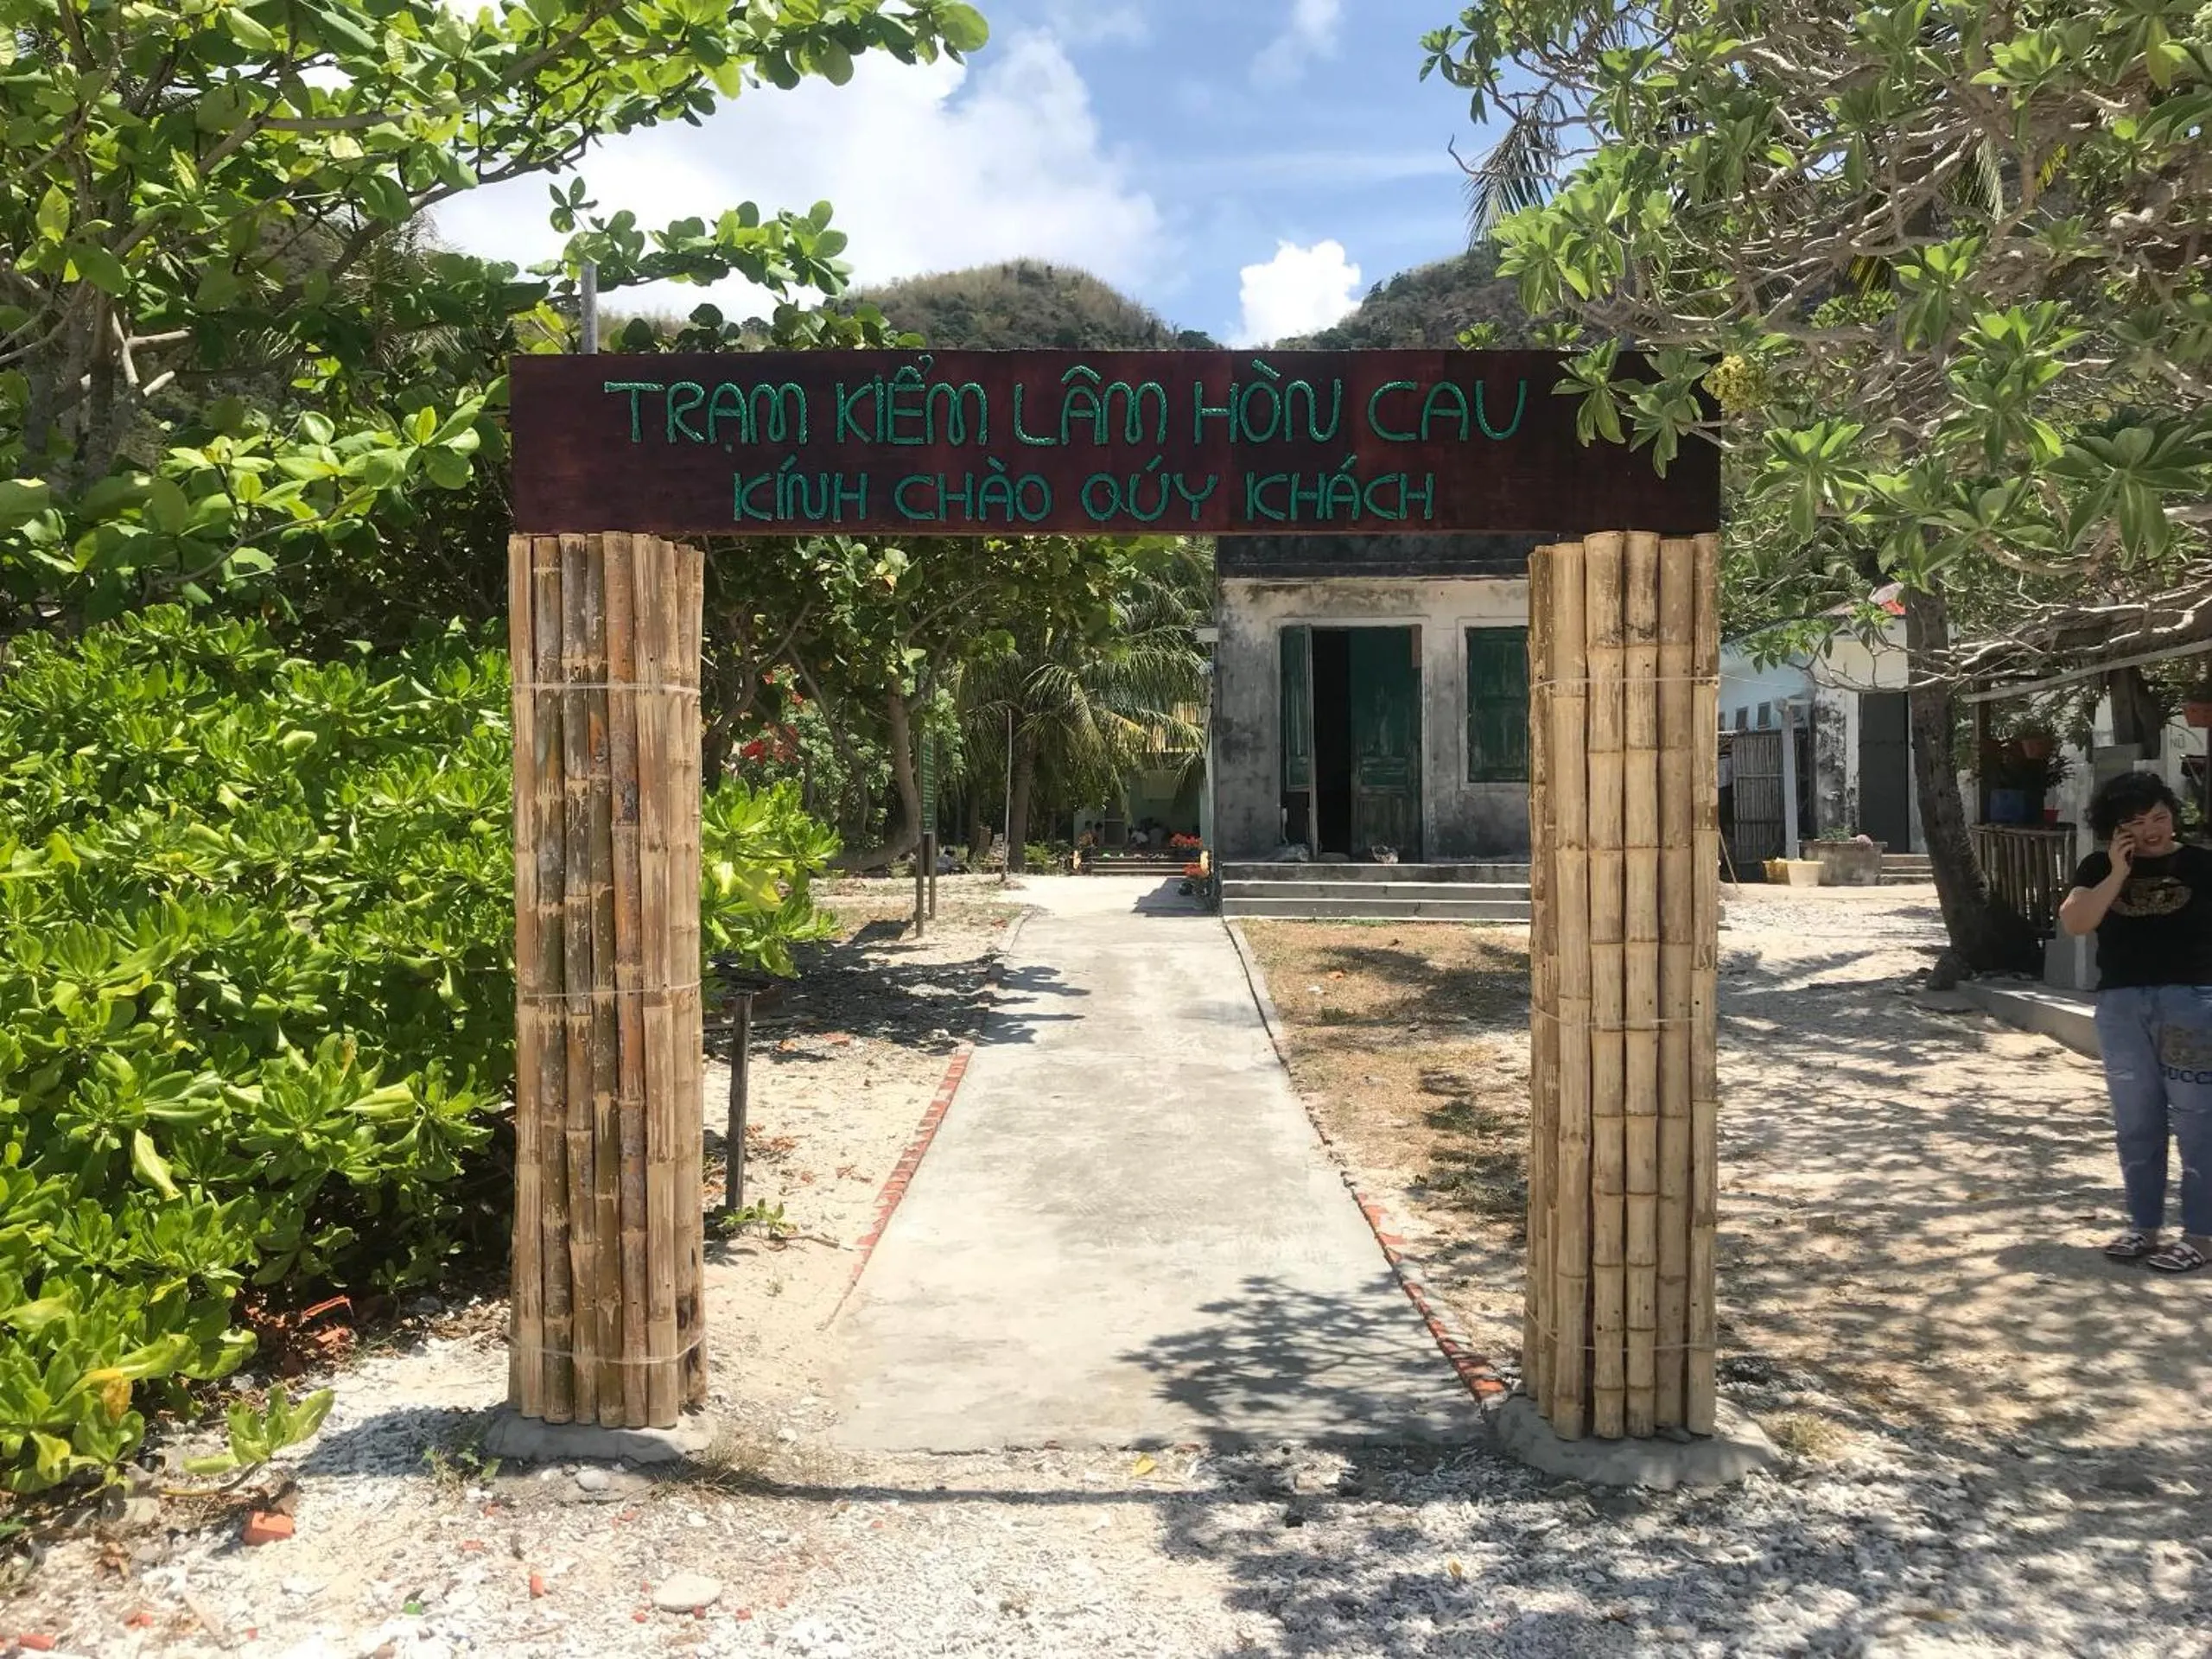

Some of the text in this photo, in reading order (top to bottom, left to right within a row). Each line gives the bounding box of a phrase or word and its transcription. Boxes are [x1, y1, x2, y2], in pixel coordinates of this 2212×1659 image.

[604, 353, 1528, 453] TRẠM KIỂM LÂM HÒN CAU
[733, 454, 868, 523] KÍNH
[893, 455, 1053, 523] CHÀO
[1244, 454, 1434, 521] KHÁCH
